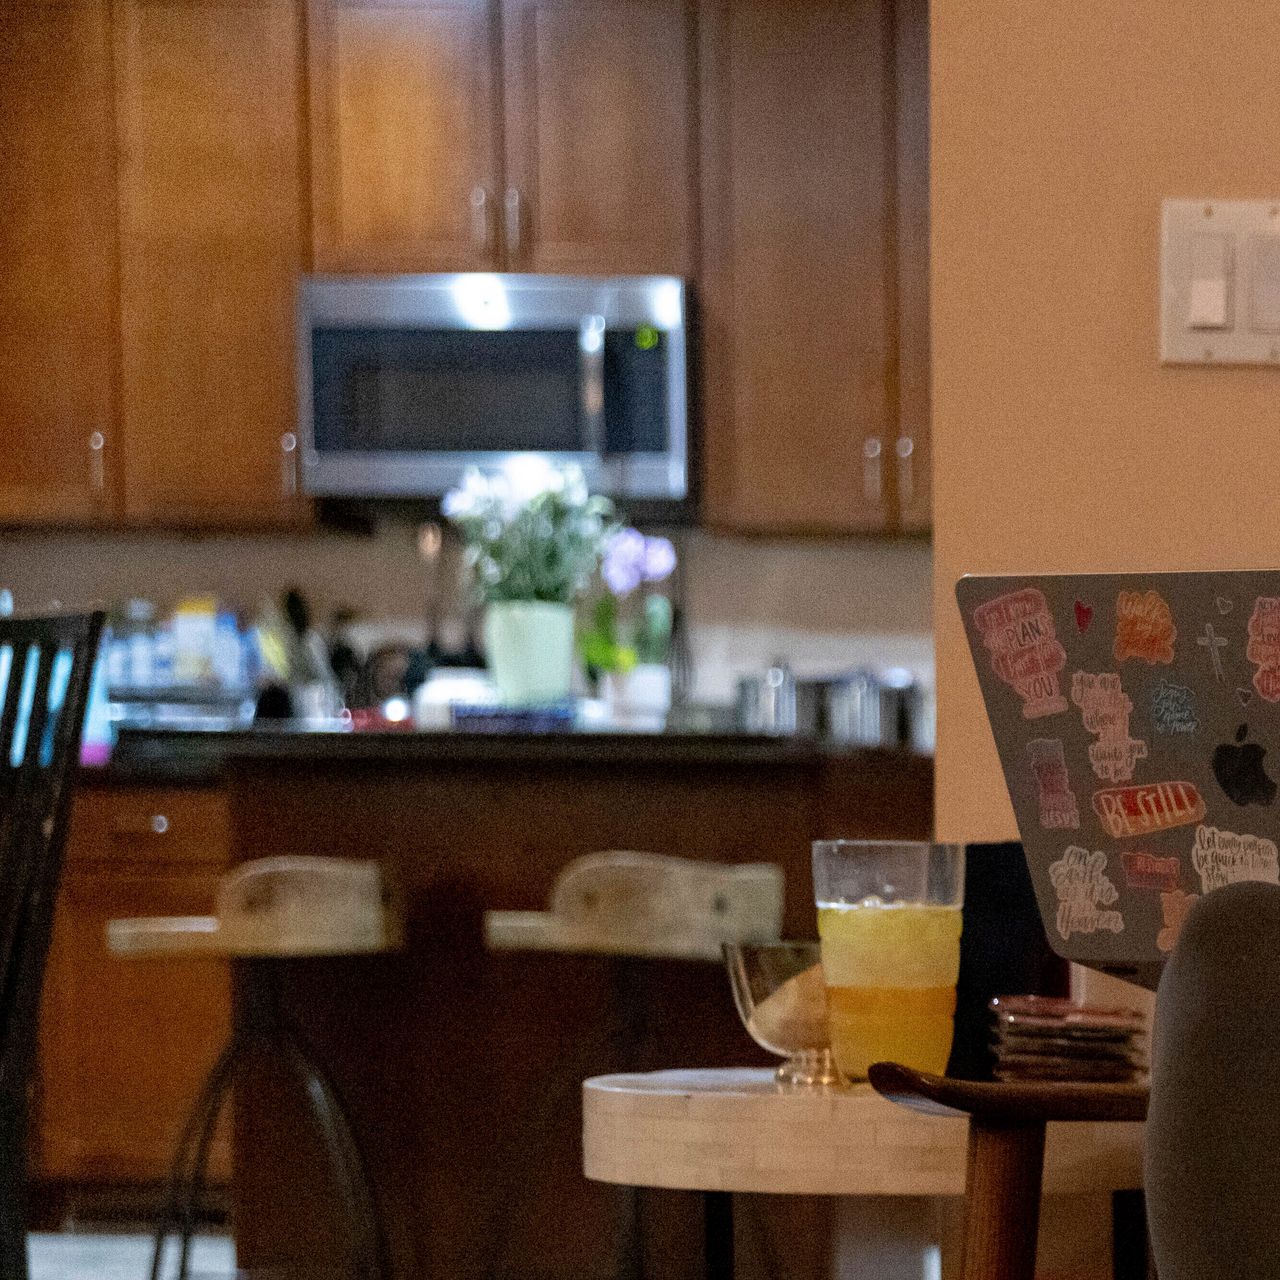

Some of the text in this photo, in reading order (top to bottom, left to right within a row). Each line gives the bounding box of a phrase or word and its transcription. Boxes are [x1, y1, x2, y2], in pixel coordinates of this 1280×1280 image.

[1005, 614, 1049, 651] PLANS
[1018, 675, 1054, 700] YOU
[1100, 783, 1197, 838] BE STILL
